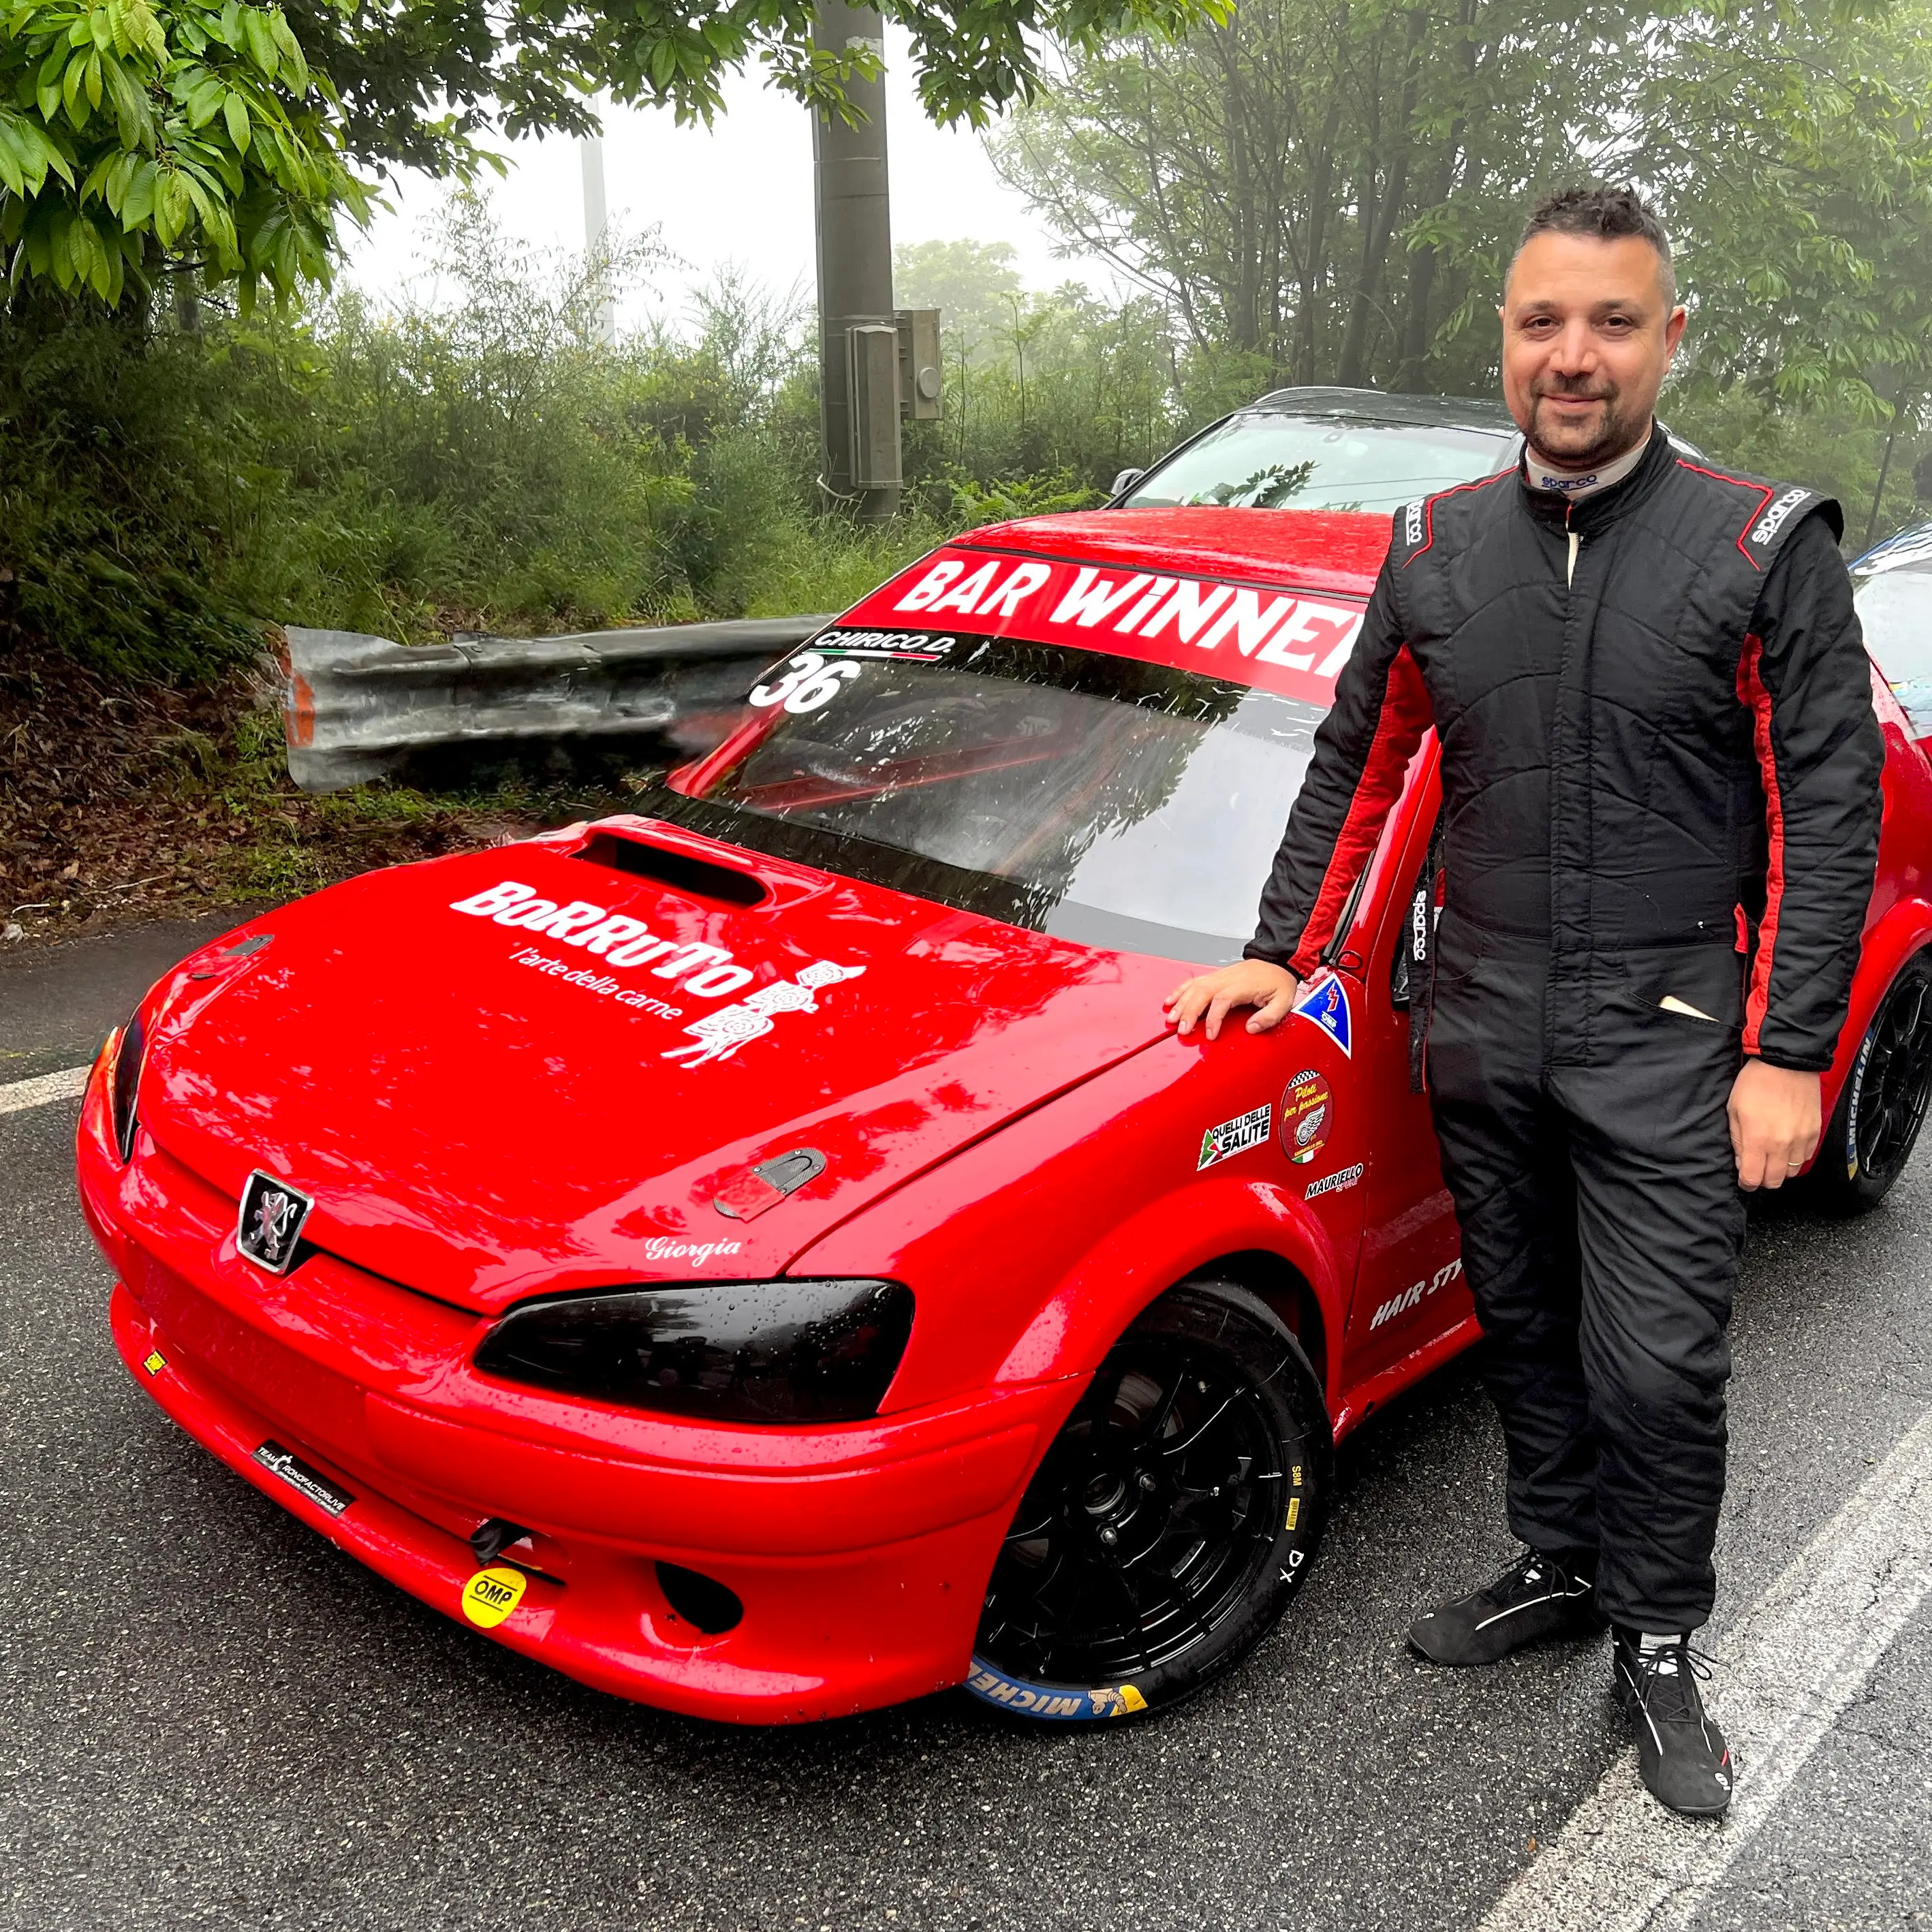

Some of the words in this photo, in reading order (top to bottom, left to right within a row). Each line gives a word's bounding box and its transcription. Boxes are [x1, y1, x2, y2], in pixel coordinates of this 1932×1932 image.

[1542, 475, 1598, 490] sparco
[1406, 499, 1424, 545] parco
[1751, 489, 1810, 544] sparco
[892, 561, 1051, 617] BAR
[815, 631, 929, 650] CHIRICO
[922, 636, 956, 653] D.
[749, 653, 861, 714] 36
[1413, 890, 1427, 961] sparco
[509, 947, 568, 976] l'arte
[562, 969, 619, 995] della
[614, 990, 683, 1020] carne
[1295, 1083, 1317, 1102] Piloti
[1298, 1091, 1328, 1115] passione
[1849, 1037, 1872, 1146] MICHELIN
[1213, 1117, 1243, 1144] QUELLI
[1245, 1105, 1271, 1127] DELLE
[1220, 1118, 1269, 1155] SALITE
[1306, 1164, 1362, 1199] MAURIELLO
[645, 1236, 742, 1267] Giorgia
[1370, 1281, 1426, 1331] HAIR
[258, 1447, 279, 1463] TEAM
[1292, 1465, 1303, 1486] S8M
[474, 1580, 513, 1605] OMP
